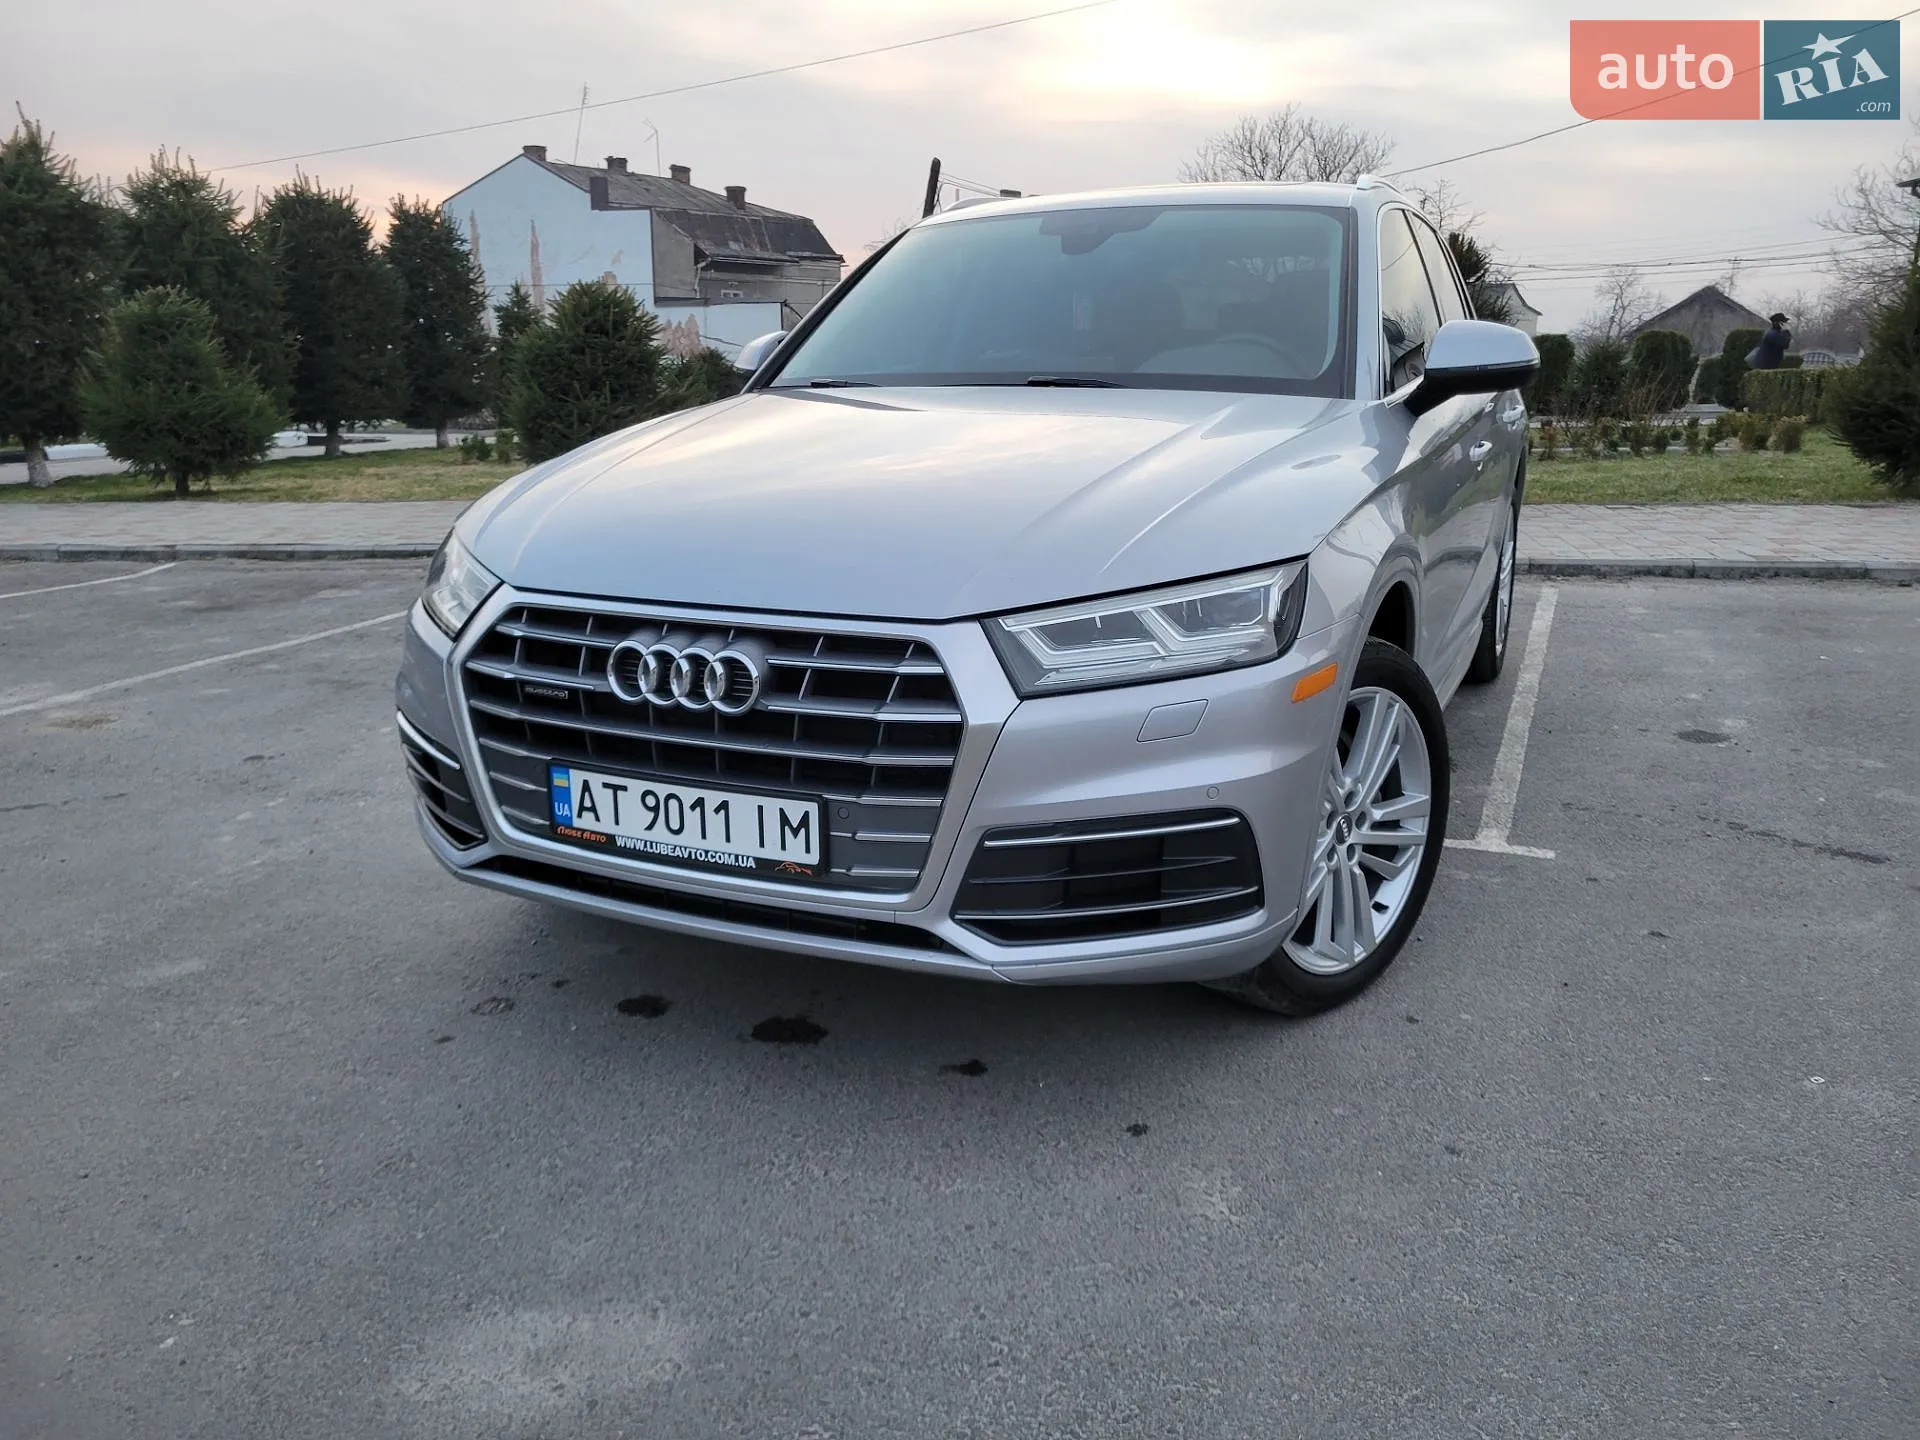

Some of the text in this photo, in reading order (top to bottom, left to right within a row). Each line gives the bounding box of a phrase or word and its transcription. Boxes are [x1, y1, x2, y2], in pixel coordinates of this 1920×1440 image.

[554, 802, 571, 817] UA
[577, 779, 811, 854] AT 9011 IM
[615, 835, 756, 869] WWW.LUBEAVTO.COM.UA
